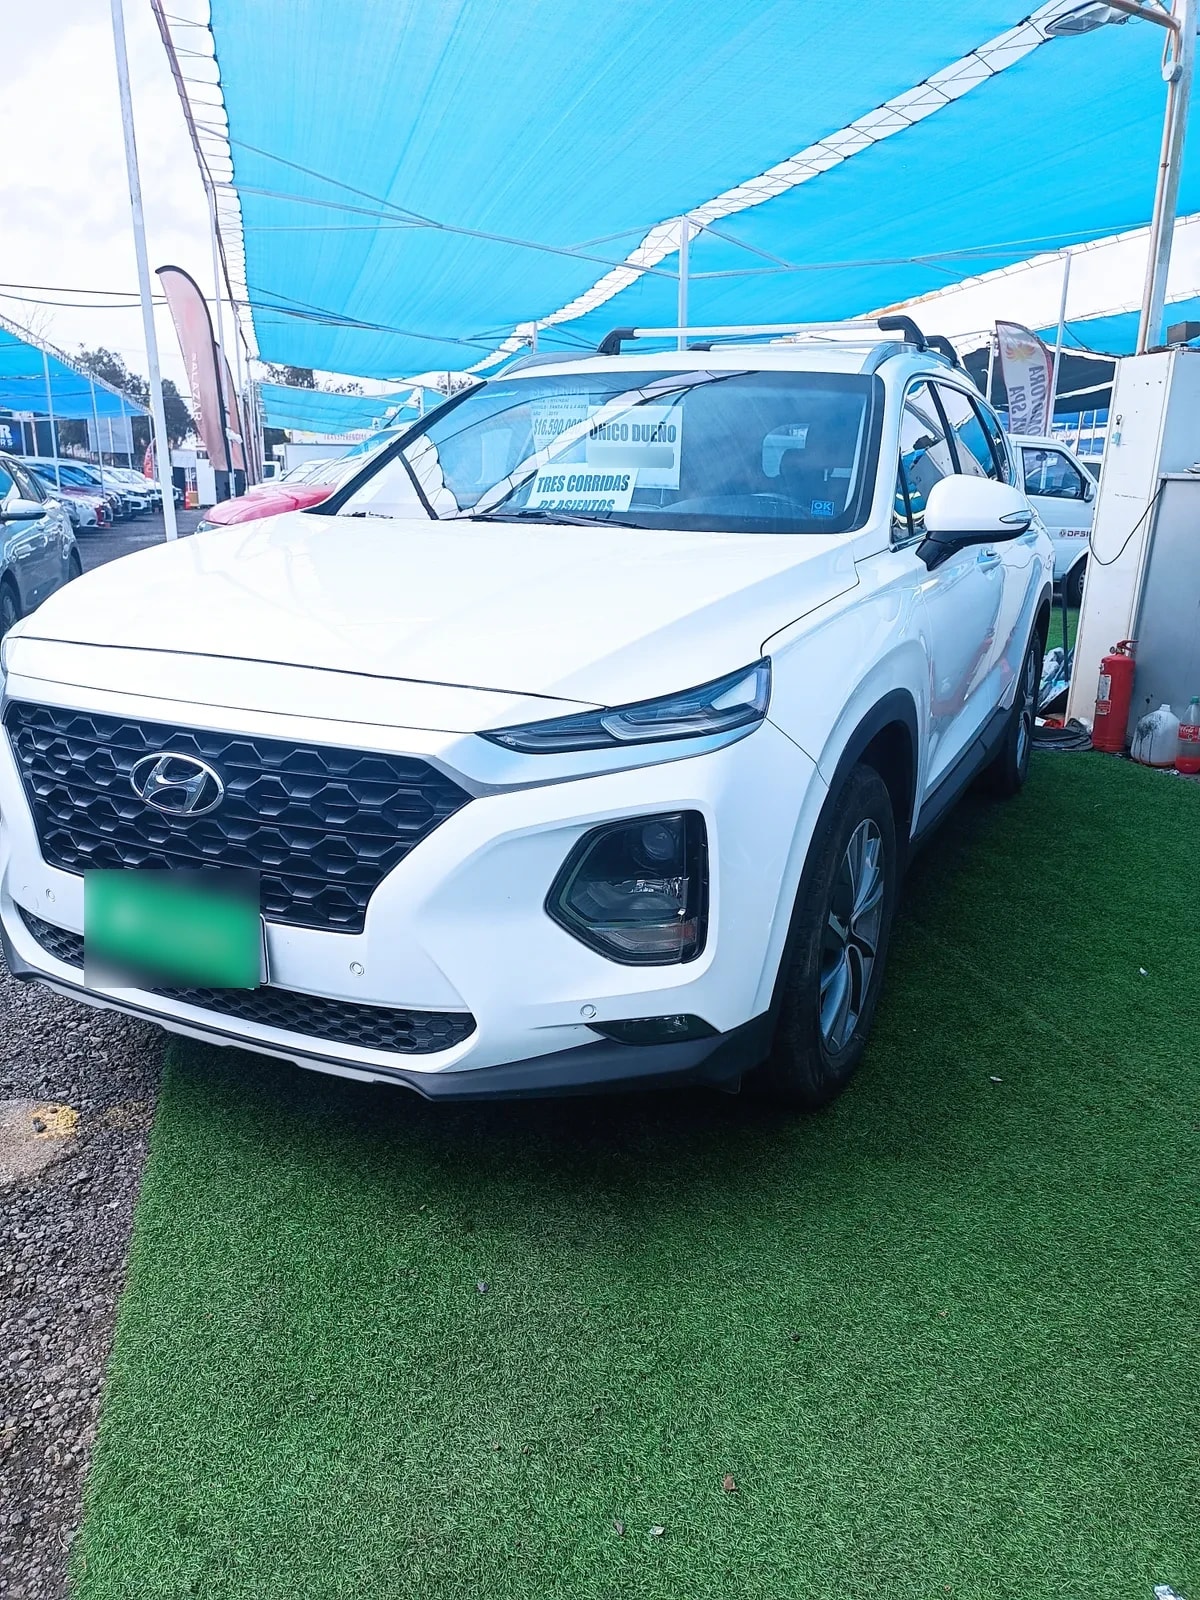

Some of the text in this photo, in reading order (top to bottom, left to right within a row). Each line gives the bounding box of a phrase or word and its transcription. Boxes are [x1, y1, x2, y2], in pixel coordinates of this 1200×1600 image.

[631, 421, 677, 443] DUEÑO
[536, 474, 631, 493] TRES CORRIDAS
[814, 502, 832, 511] OK
